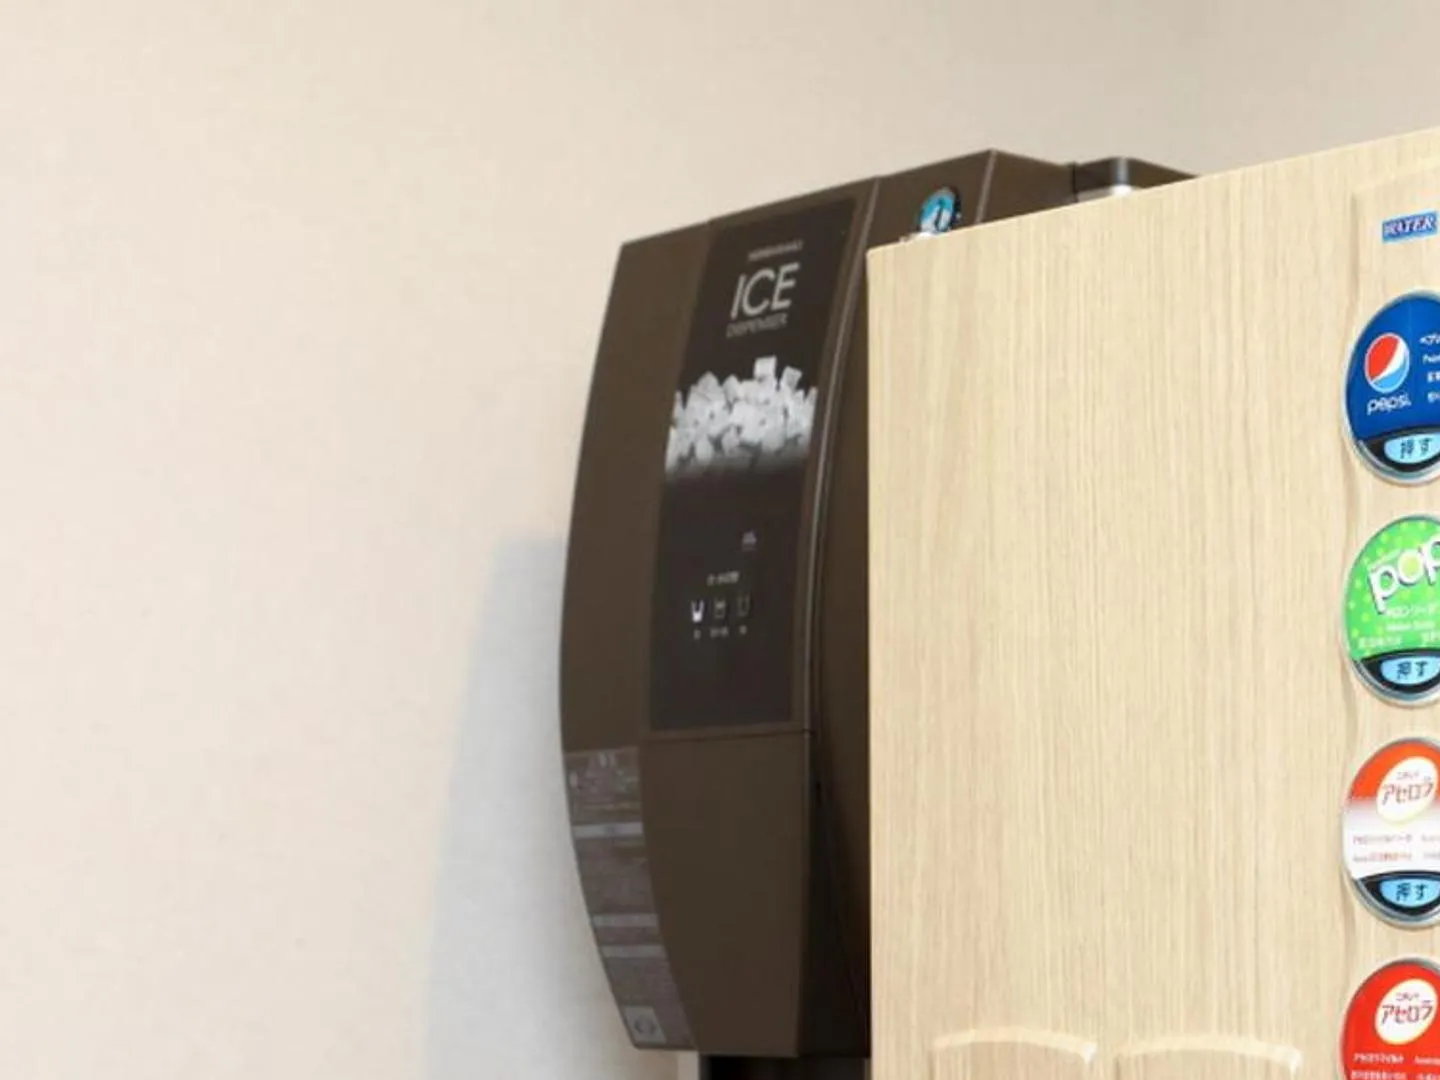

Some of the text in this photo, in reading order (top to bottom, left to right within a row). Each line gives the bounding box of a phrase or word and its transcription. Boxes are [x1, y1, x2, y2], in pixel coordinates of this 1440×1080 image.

[730, 261, 800, 320] ICE
[1367, 392, 1411, 415] pepsi
[1382, 777, 1433, 805] アセロラ
[1381, 1000, 1434, 1025] アセロラ
